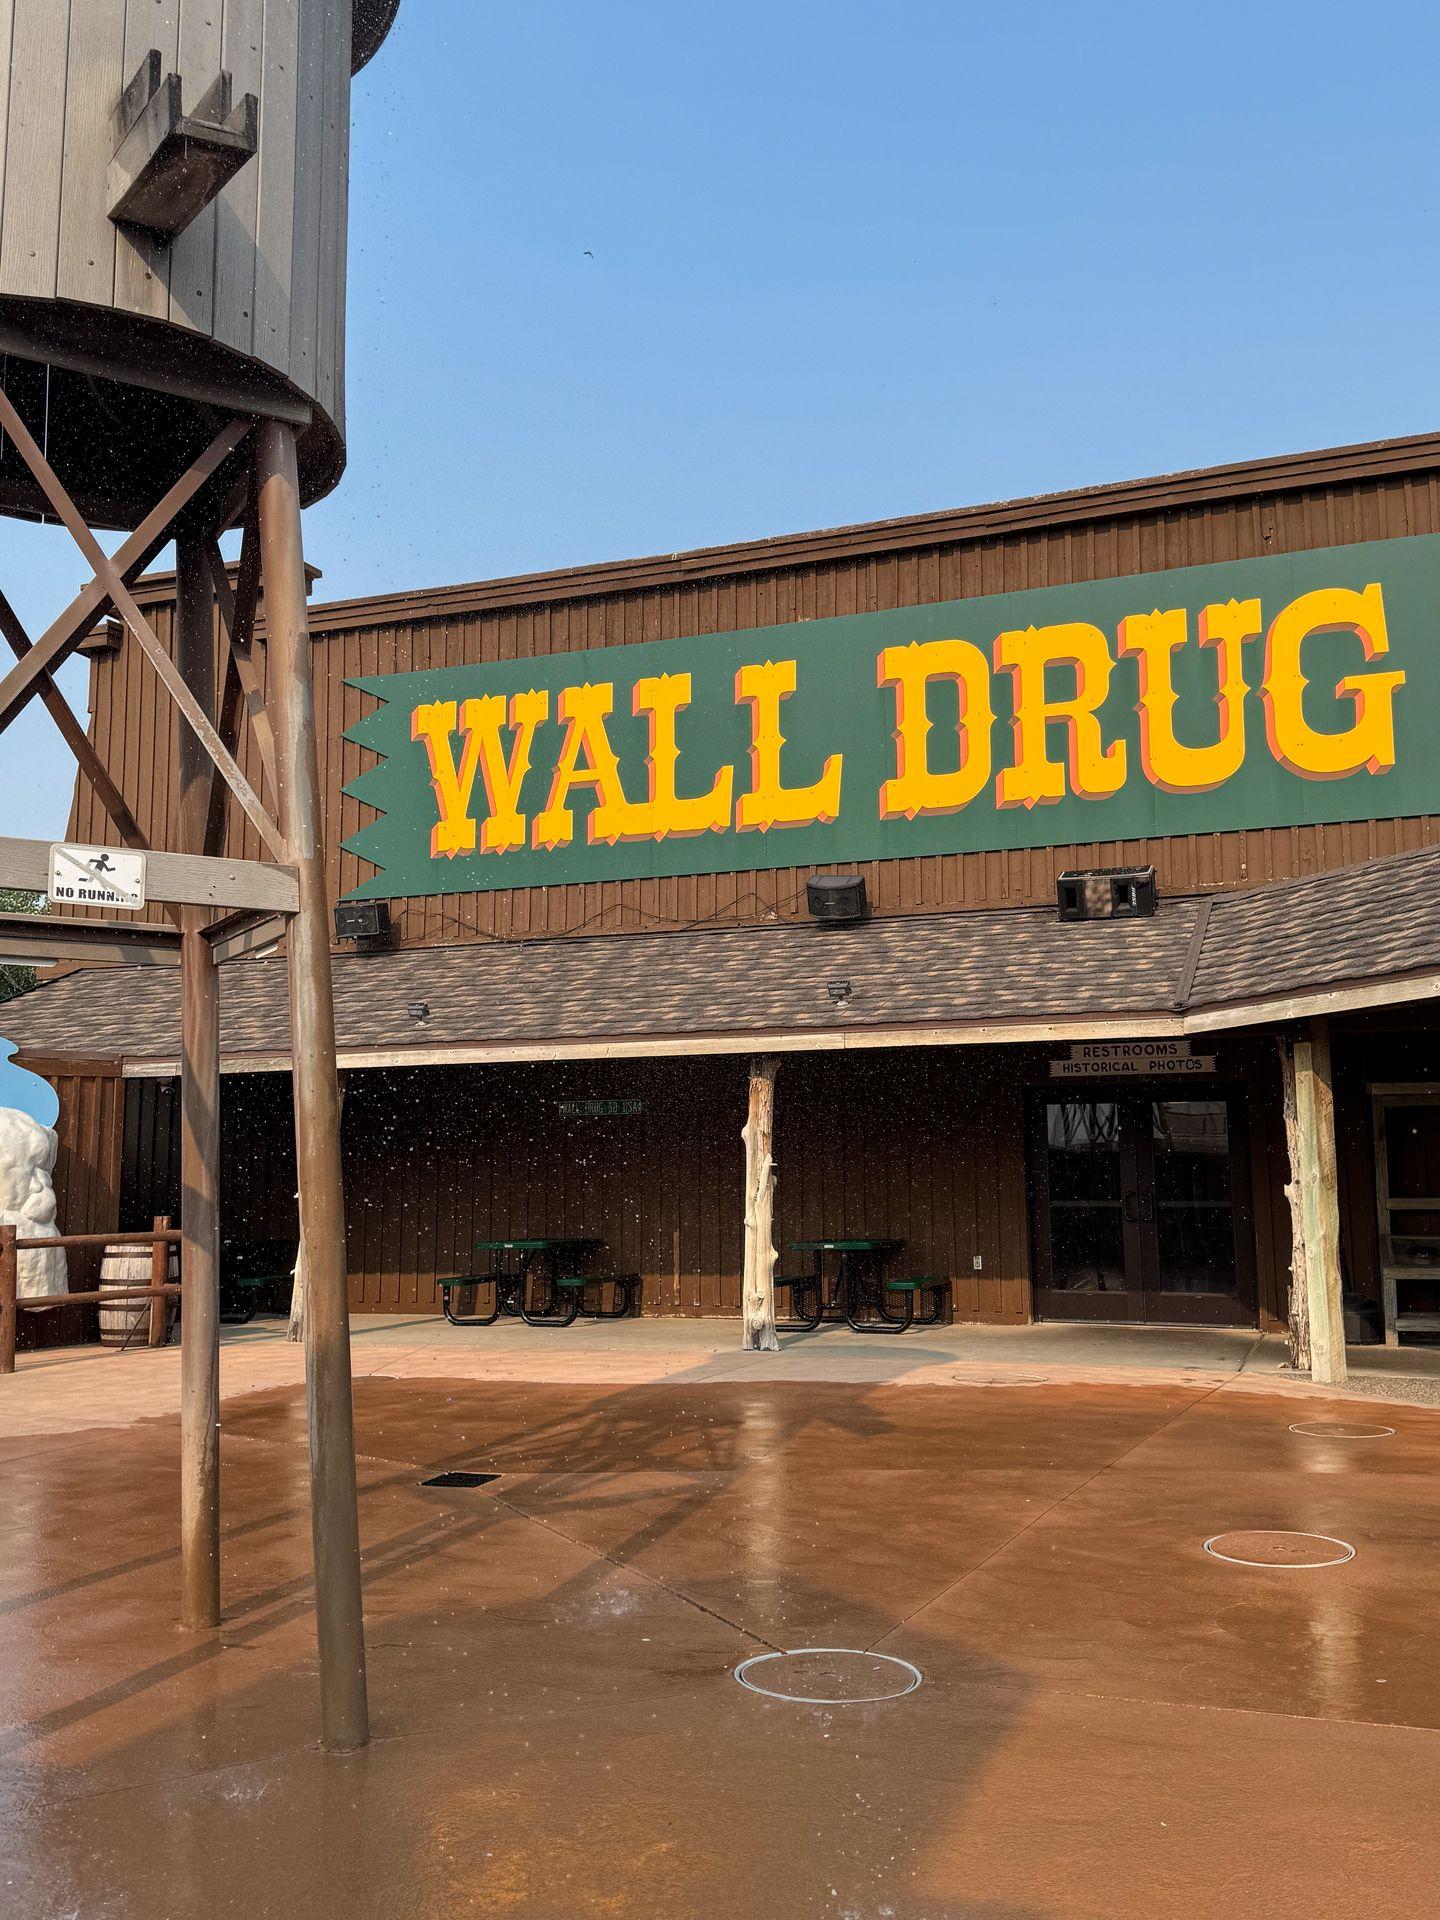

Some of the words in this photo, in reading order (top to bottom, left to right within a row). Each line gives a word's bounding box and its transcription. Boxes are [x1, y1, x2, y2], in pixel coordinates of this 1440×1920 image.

[411, 660, 843, 860] WALL
[877, 583, 1406, 821] DRUG
[56, 886, 74, 898] NO
[79, 888, 139, 903] RUNN
[1083, 1043, 1178, 1058] RESTROOMS
[1062, 1061, 1138, 1074] HISTORICAL
[1149, 1058, 1203, 1071] PHOTOS
